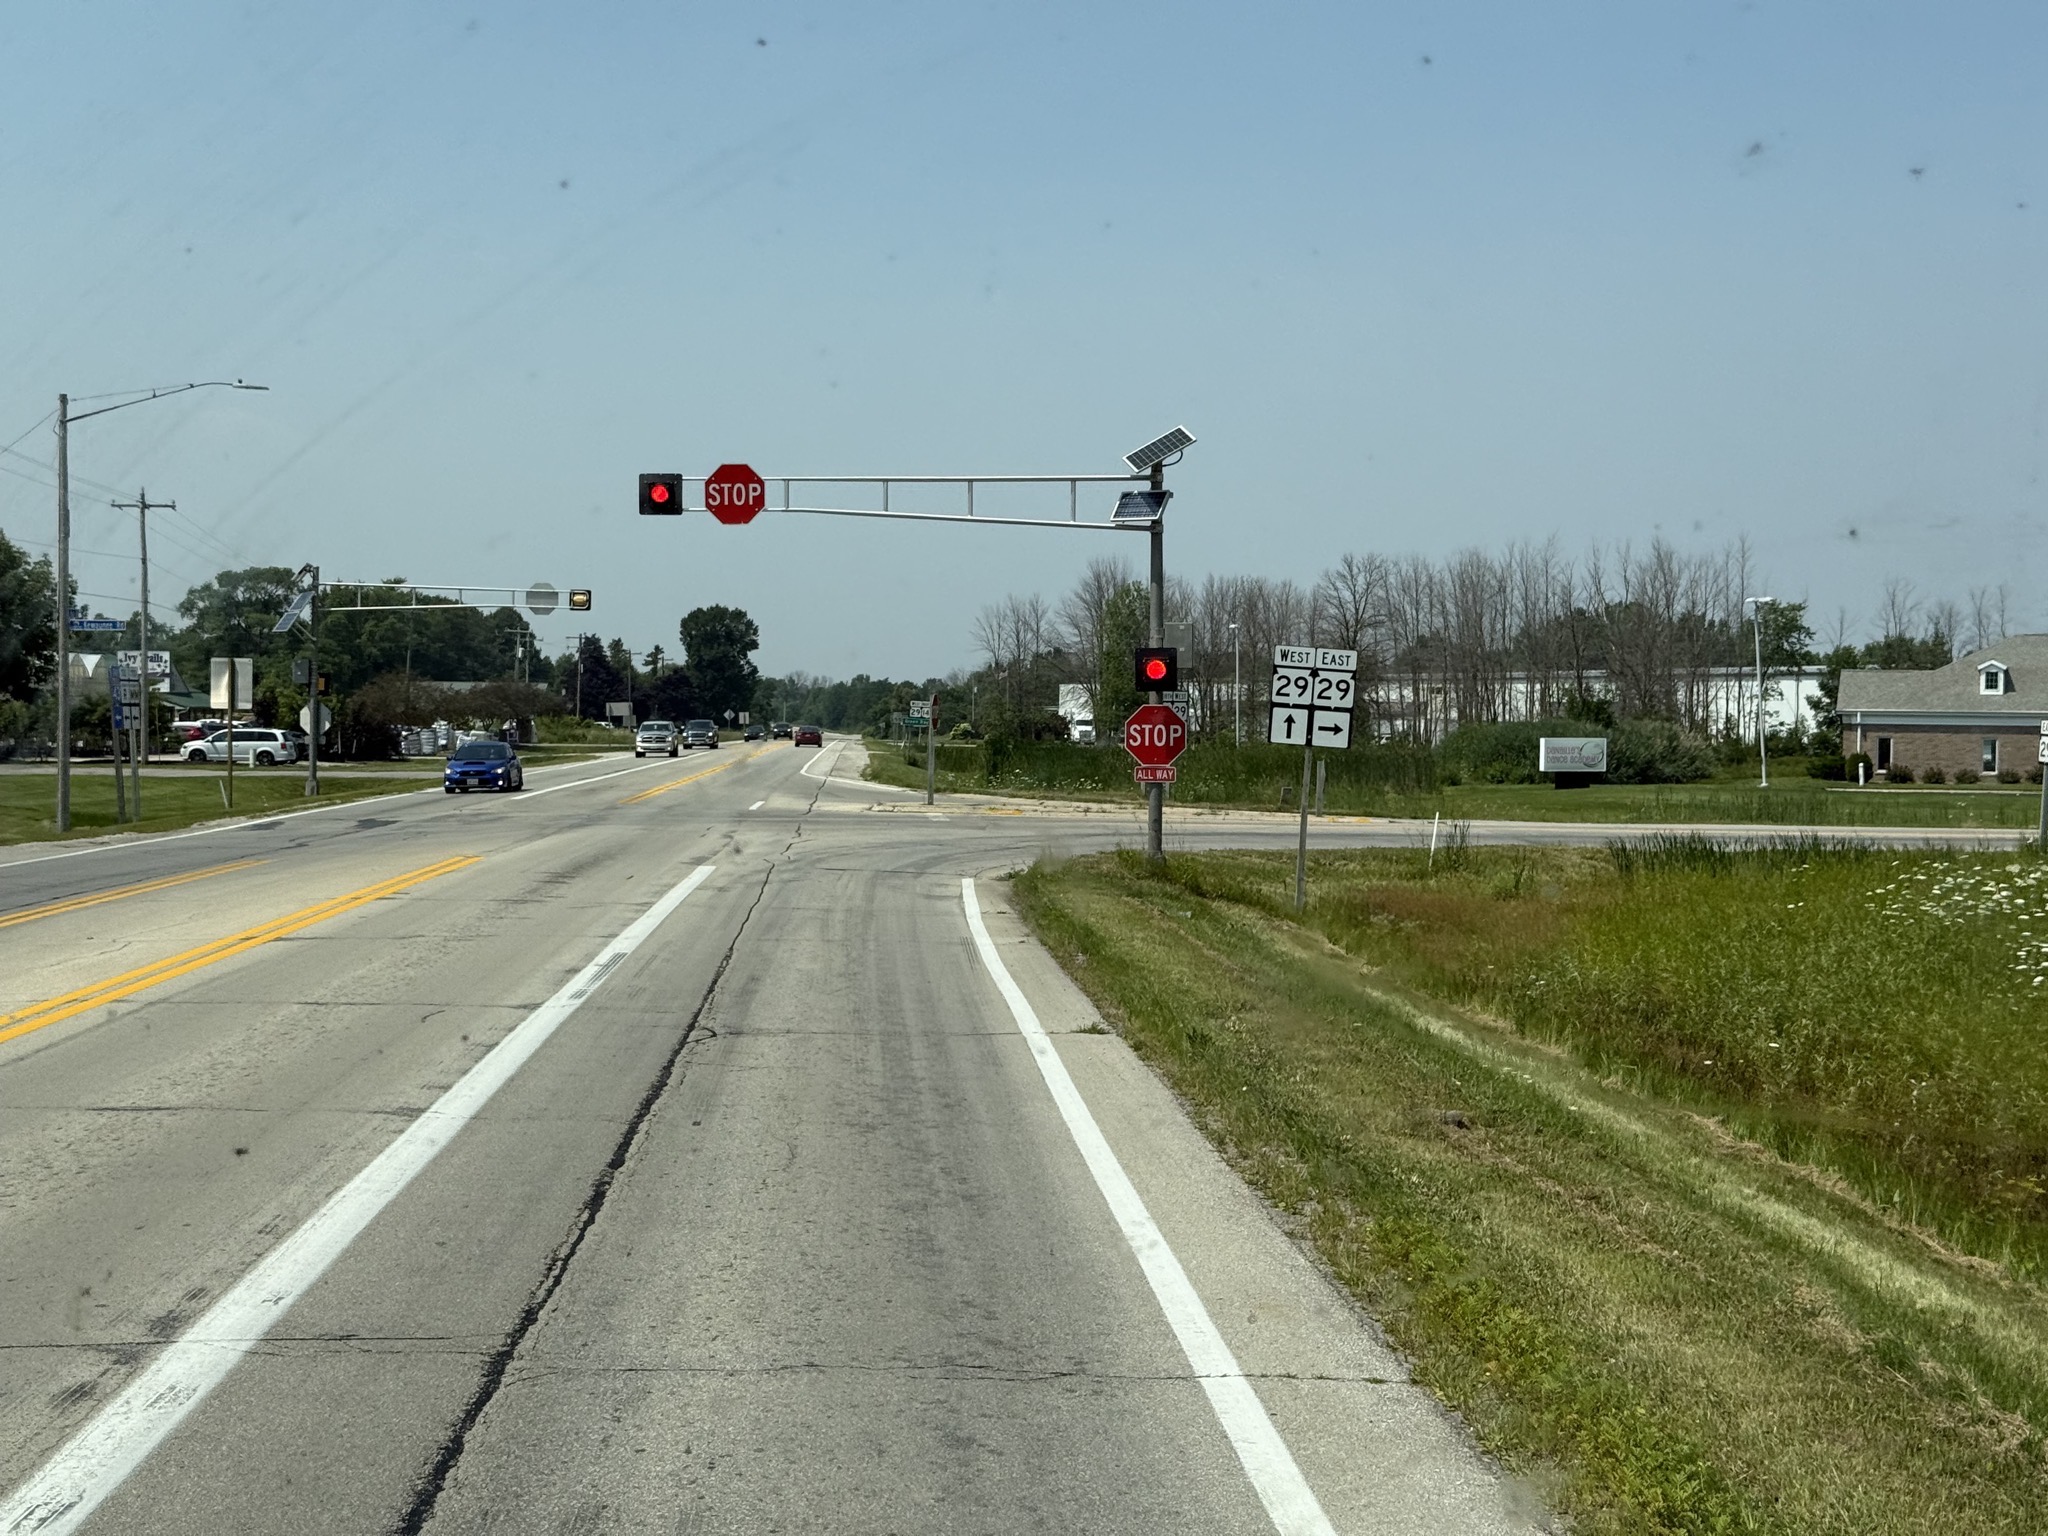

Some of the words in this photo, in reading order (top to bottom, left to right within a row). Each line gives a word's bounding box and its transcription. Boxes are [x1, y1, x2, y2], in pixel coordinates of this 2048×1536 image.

[708, 483, 762, 506] STOP
[124, 652, 138, 664] Ivy
[1279, 651, 1311, 665] WEST
[1321, 652, 1351, 667] EAST
[1275, 675, 1309, 698] 29
[1317, 678, 1351, 701] 29
[1129, 724, 1182, 747] STOP
[1137, 769, 1153, 780] ALL
[1155, 769, 1175, 780] WAY
